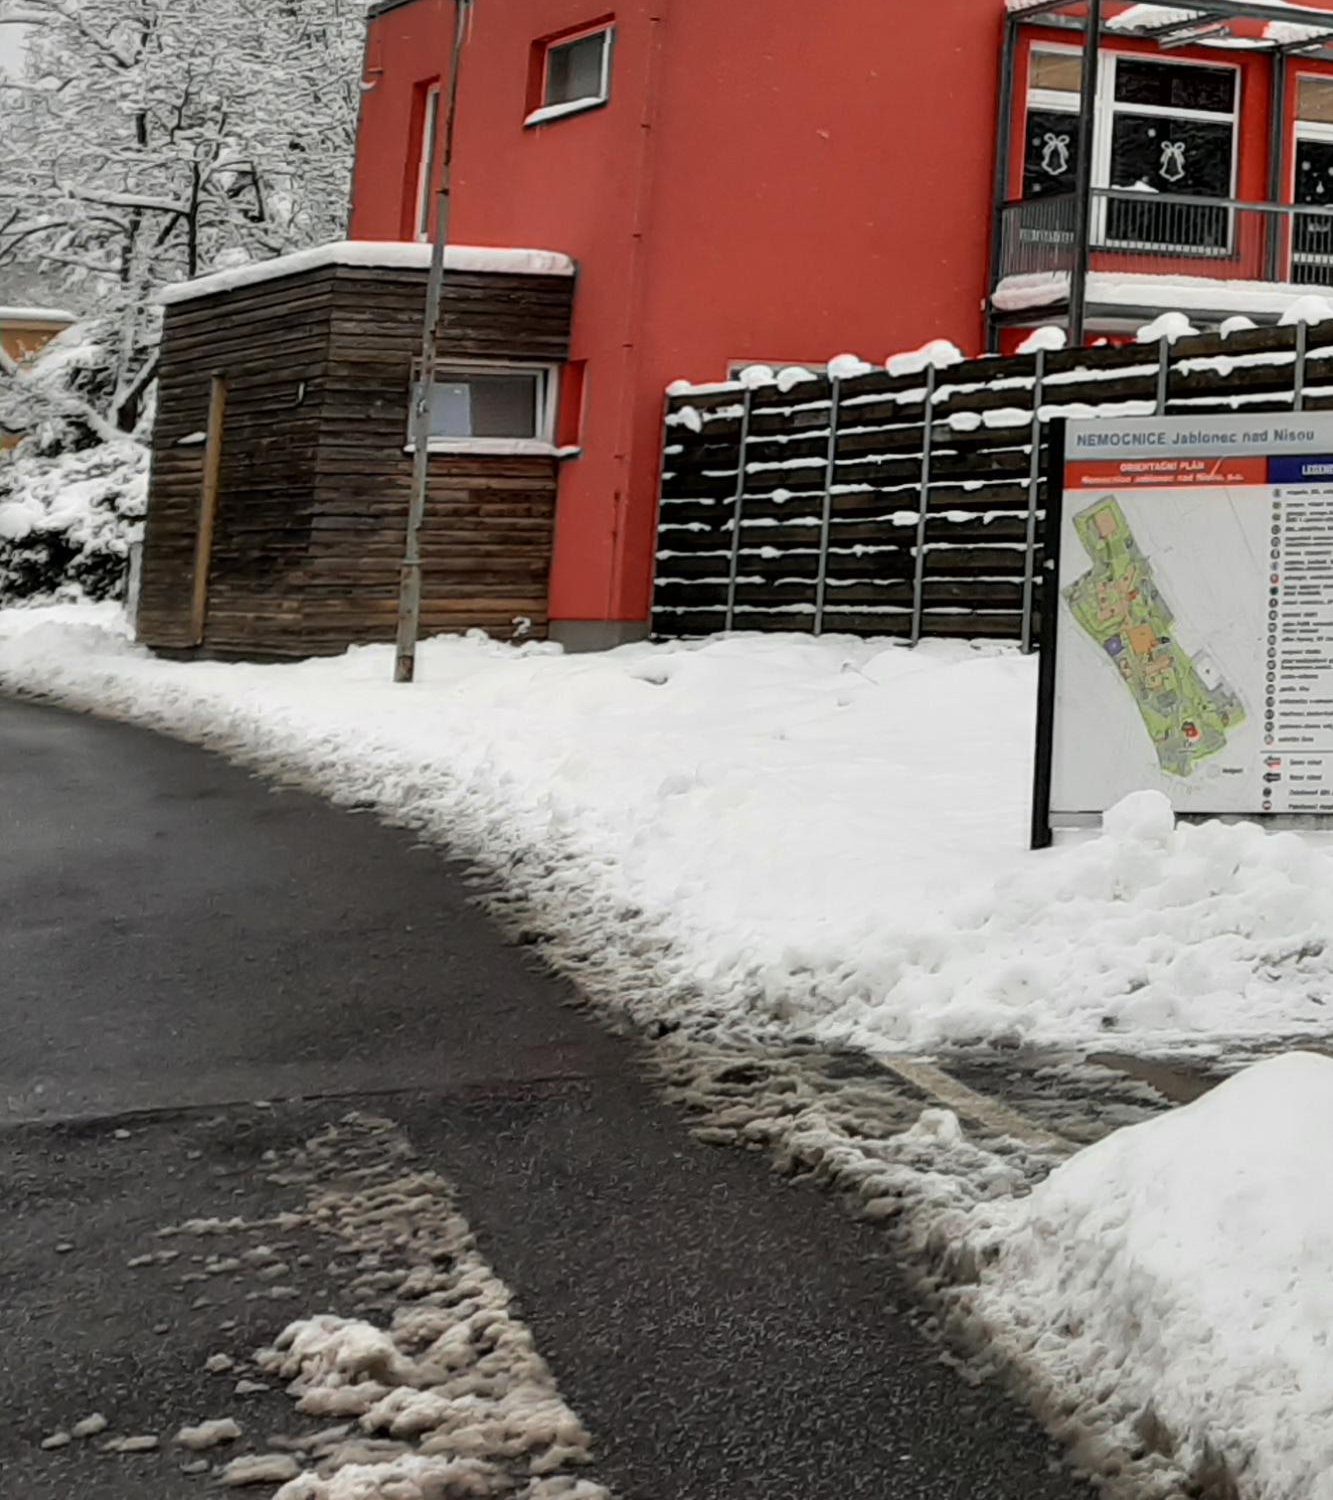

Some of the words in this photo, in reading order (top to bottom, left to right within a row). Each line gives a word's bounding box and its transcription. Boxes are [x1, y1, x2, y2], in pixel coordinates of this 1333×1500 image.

[1076, 432, 1166, 446] NEMOCNICE
[1172, 431, 1237, 445] Jablonec
[1242, 430, 1268, 443] nad
[1274, 429, 1315, 441] Nisou
